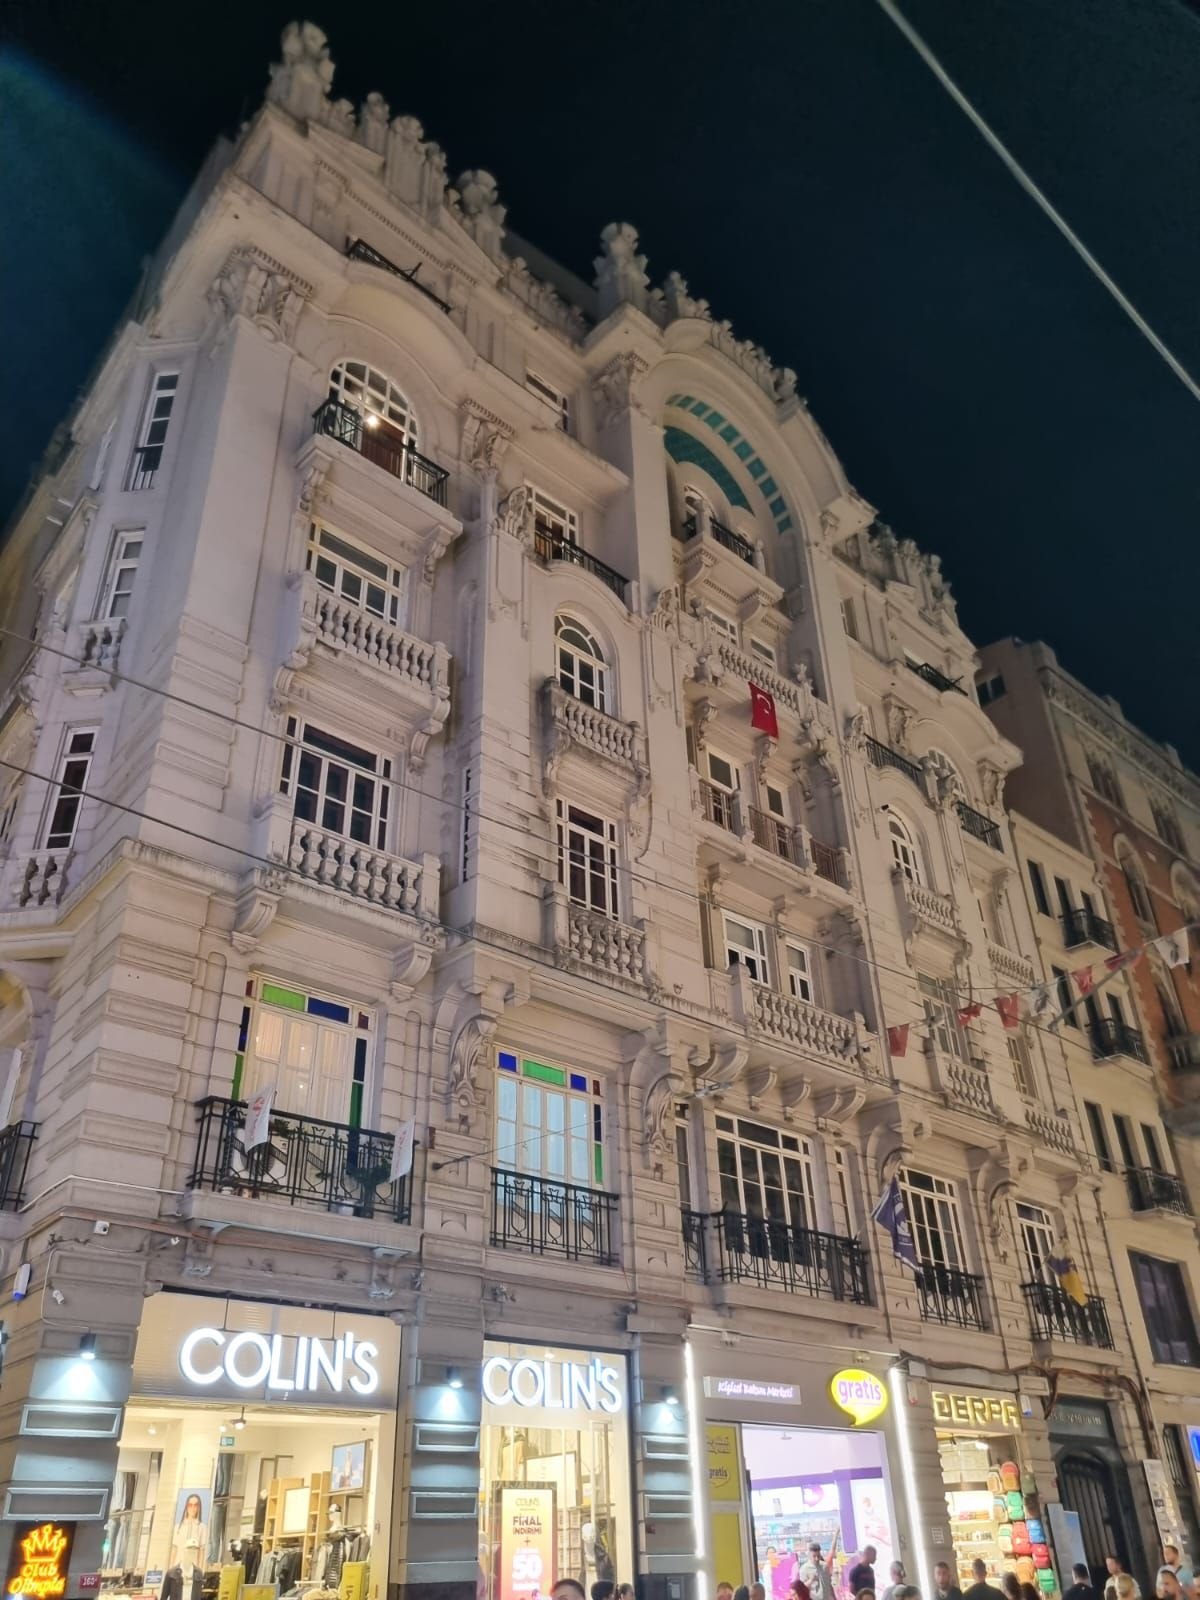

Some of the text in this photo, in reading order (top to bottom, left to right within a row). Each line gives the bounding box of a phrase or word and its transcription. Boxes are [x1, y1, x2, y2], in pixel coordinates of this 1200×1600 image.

[179, 1328, 379, 1394] COLIN'S
[482, 1356, 622, 1413] COLIN'S
[838, 1376, 881, 1404] gratis
[22, 1563, 57, 1578] Club
